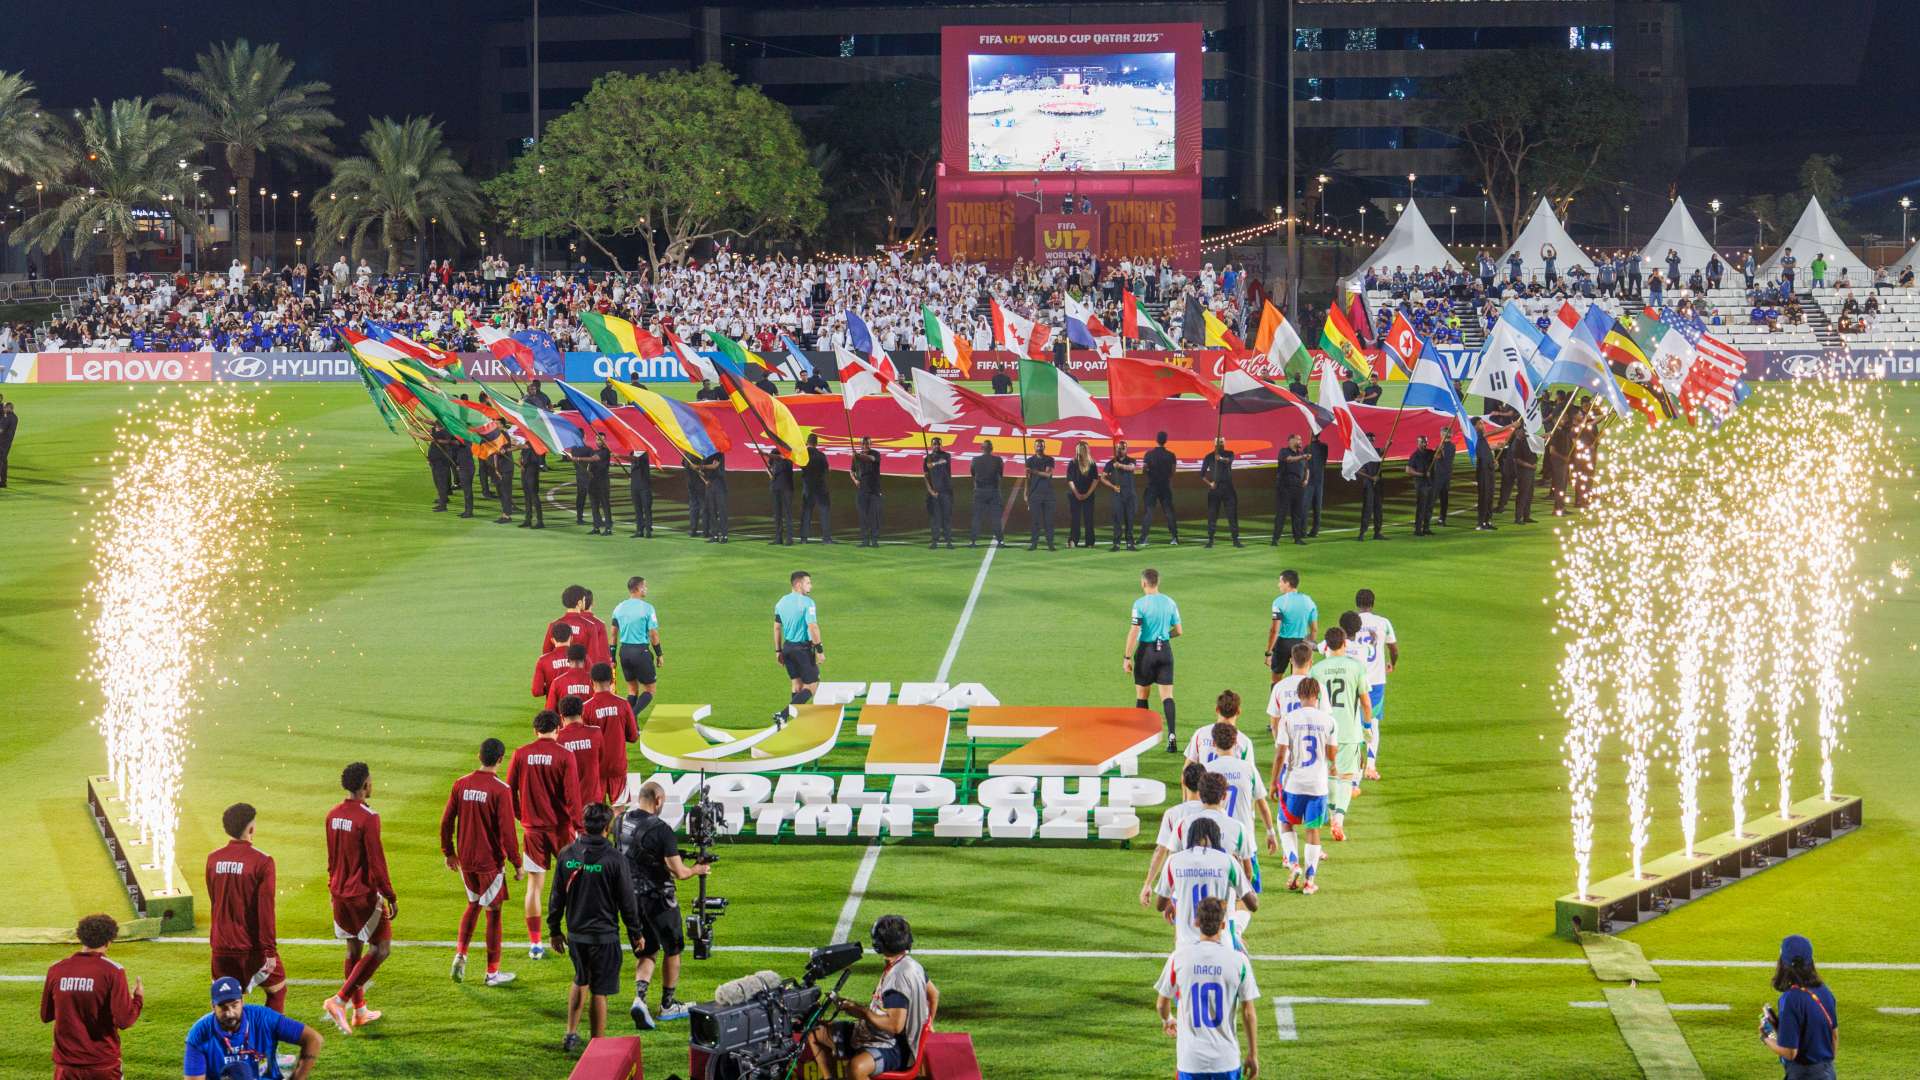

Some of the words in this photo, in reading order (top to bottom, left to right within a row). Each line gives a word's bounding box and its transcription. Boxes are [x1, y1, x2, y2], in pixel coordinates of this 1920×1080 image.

[979, 35, 1002, 45] FIFA
[1004, 35, 1025, 44] U17
[1028, 35, 1068, 44] WORLD
[1069, 34, 1091, 44] CUP
[1093, 34, 1131, 45] QATAR
[947, 202, 1015, 224] TMRW'S
[1107, 200, 1176, 222] TMRW'S
[1057, 222, 1077, 230] FIFA
[949, 224, 1015, 259] GOAT
[1043, 230, 1091, 250] U17
[1108, 223, 1176, 258] GOAT
[66, 355, 184, 381] Lenovo
[273, 363, 358, 376] HYUND
[593, 356, 691, 378] aram
[976, 361, 999, 370] FIFA
[1084, 361, 1108, 372] QAT
[1439, 352, 1482, 379] VI
[1831, 356, 1920, 374] HYUND
[568, 685, 590, 694] QATAR
[813, 682, 1000, 707] FIFA
[1326, 678, 1345, 708] 12
[595, 706, 618, 719] QATAR
[565, 739, 592, 751] QATAR
[639, 703, 1163, 777] U17
[528, 754, 552, 766] QATAR
[1301, 735, 1318, 767] 3
[463, 789, 487, 803] QATAR
[626, 772, 957, 810] WORLD
[977, 775, 1167, 807] CUP
[332, 818, 353, 832] QATAR
[934, 804, 1141, 840] 2025
[216, 861, 243, 875] QATAR
[60, 977, 94, 992] QATAR
[1192, 982, 1224, 1028] 10
